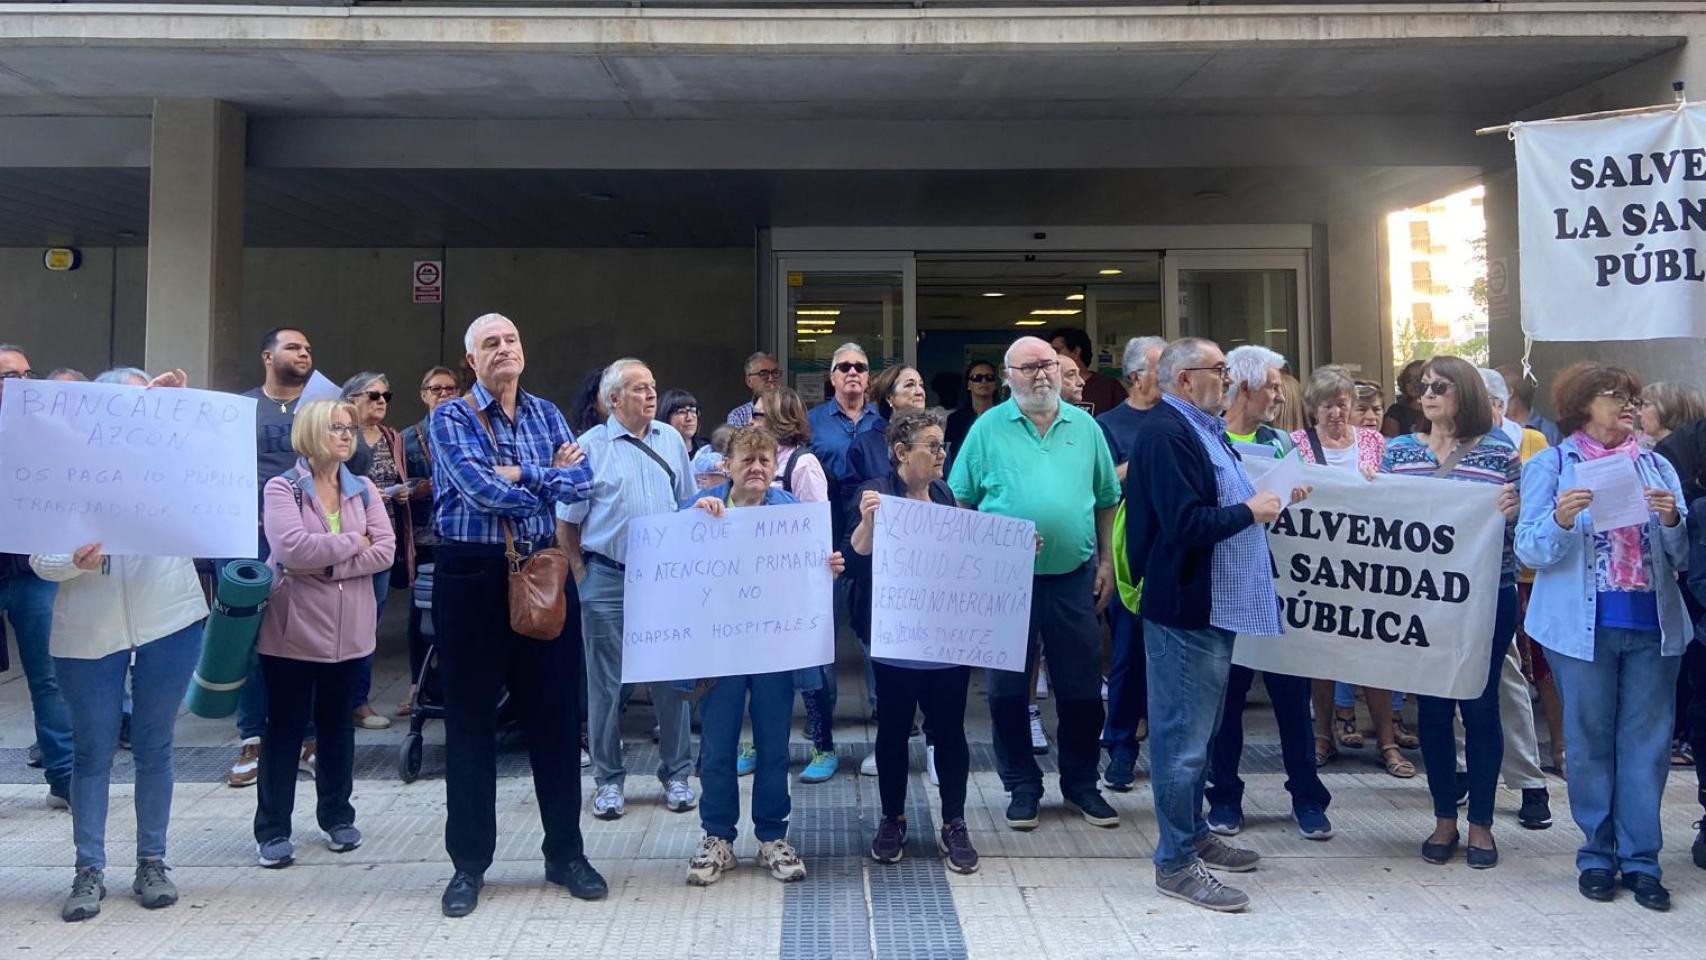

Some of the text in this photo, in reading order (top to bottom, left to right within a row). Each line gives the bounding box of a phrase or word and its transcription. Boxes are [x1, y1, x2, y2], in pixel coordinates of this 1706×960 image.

[1570, 148, 1706, 190] SALVE
[1553, 198, 1706, 239] LA SAN
[1594, 243, 1705, 287] PÚBL
[22, 388, 240, 423] BANCALERO
[15, 466, 50, 482] OS
[67, 467, 122, 483] PAGA
[630, 517, 812, 549] HAY QUE MIMAR
[1264, 507, 1455, 555] ALVEMOS
[627, 549, 828, 584] LA ATENCION PRIMARIA
[957, 554, 983, 581] ES
[994, 557, 1028, 585] UN
[1290, 553, 1470, 603] SANIDAD
[702, 586, 762, 608] Y NO
[624, 616, 820, 647] COLAPSAR HOSPITALES
[935, 626, 993, 645] PUENTE
[1276, 589, 1430, 647] ÚBLICA
[922, 645, 1008, 665] SANTIAGO
